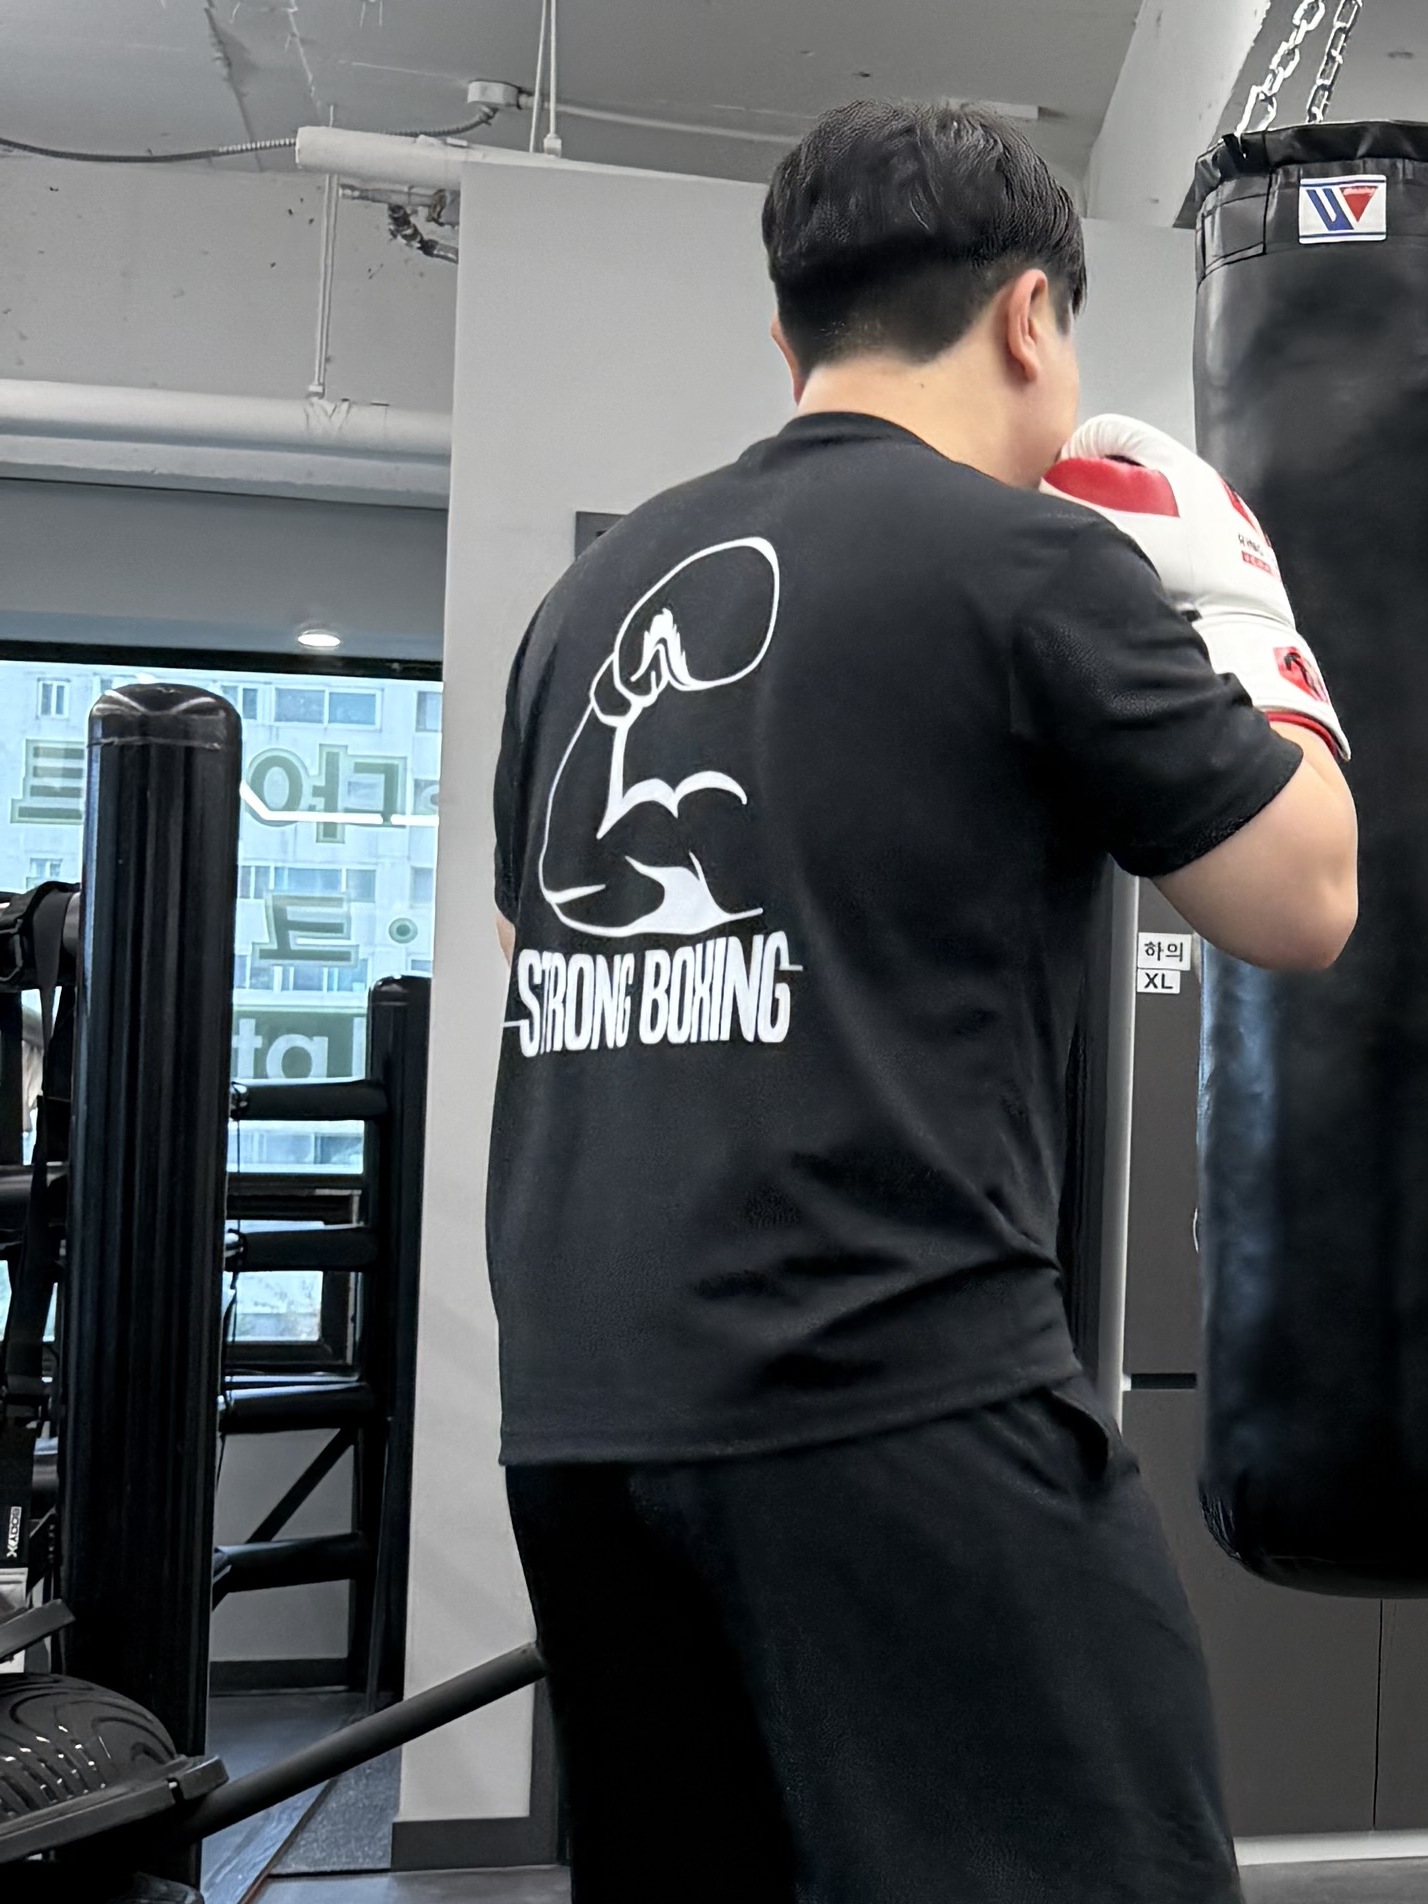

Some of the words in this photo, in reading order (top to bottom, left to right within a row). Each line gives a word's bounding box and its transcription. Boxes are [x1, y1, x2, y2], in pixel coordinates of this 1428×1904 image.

[1143, 941, 1184, 963] 하의
[1143, 971, 1174, 990] XL
[504, 948, 635, 1059] STRONG
[638, 930, 804, 1045] BOXING
